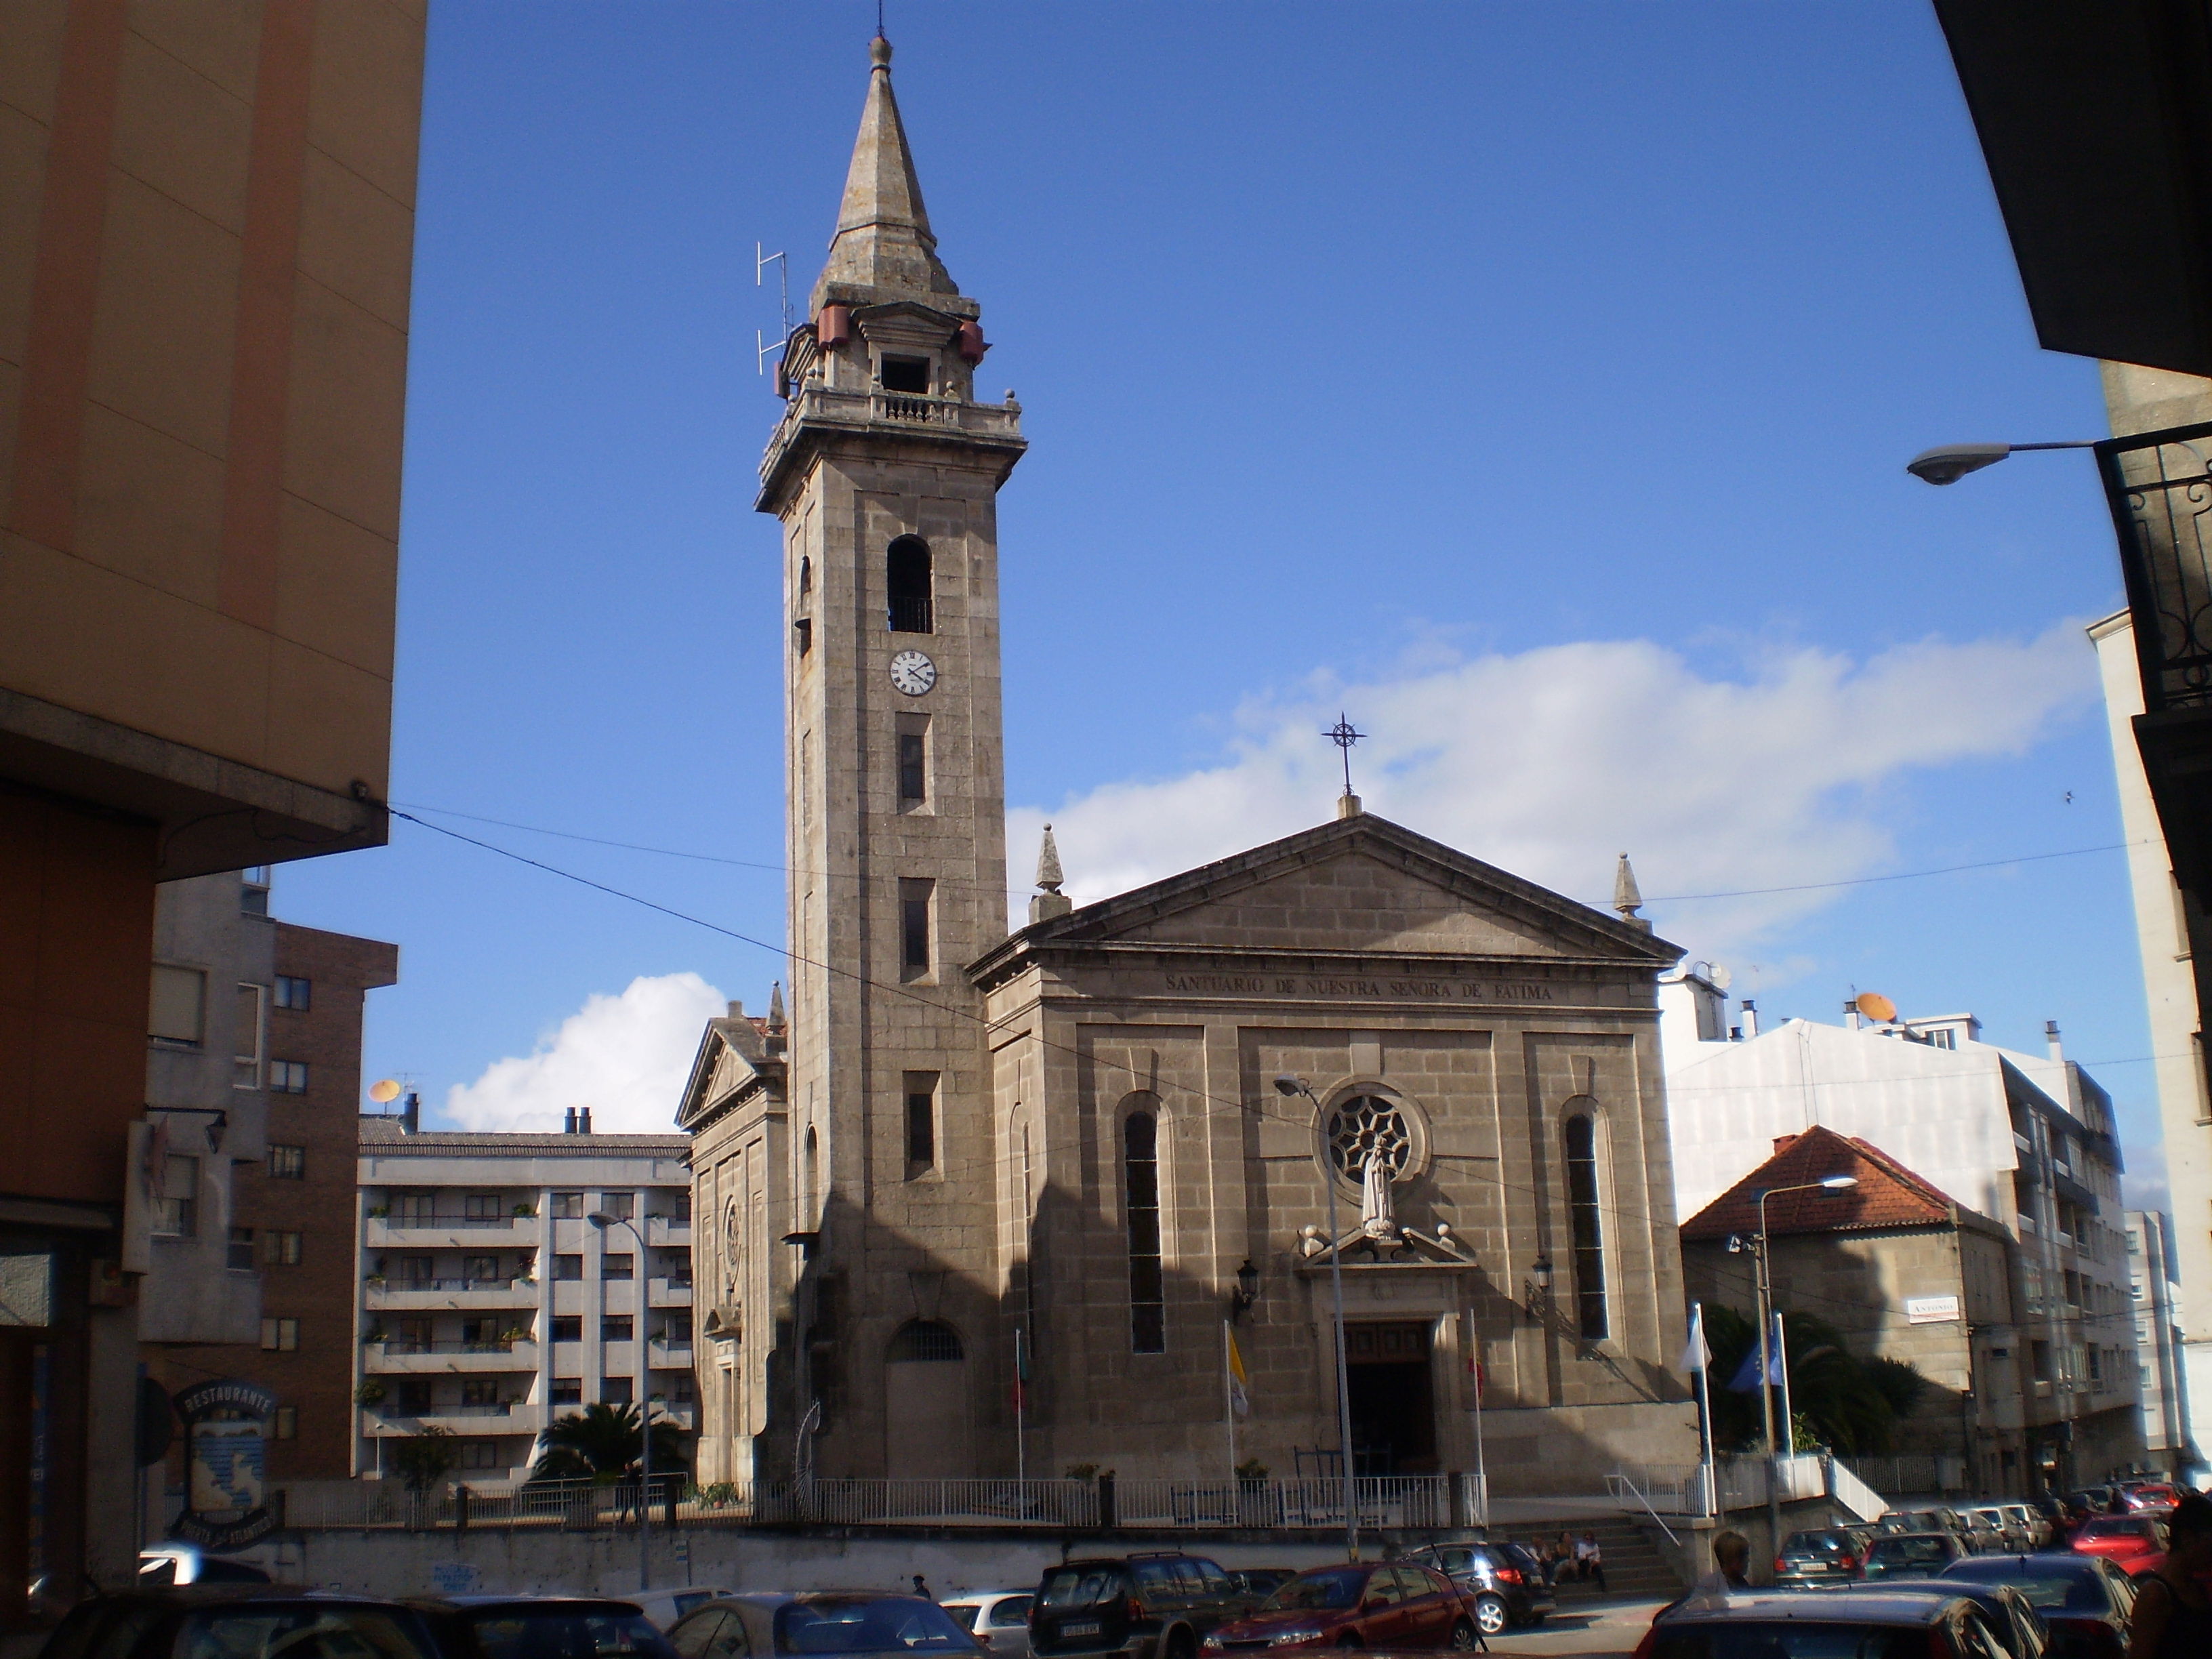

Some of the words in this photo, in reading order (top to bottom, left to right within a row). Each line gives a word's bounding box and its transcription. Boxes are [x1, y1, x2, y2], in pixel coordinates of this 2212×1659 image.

[1165, 974, 1264, 992] SANTUARIO
[1275, 979, 1296, 994] DE
[1305, 980, 1380, 997] NUESTRA
[1462, 983, 1482, 998] DE
[184, 1386, 272, 1413] RESTAURANTE
